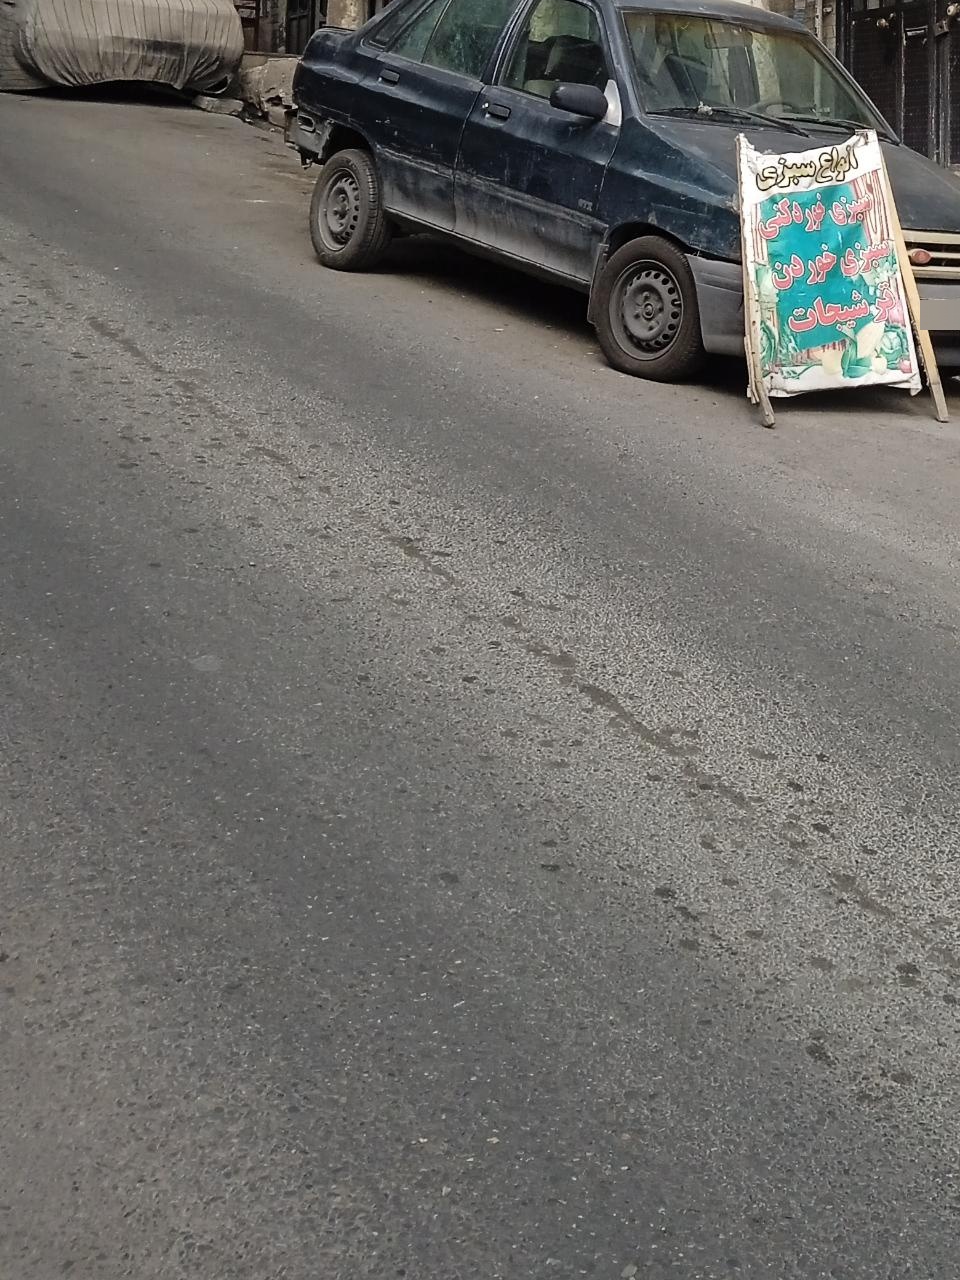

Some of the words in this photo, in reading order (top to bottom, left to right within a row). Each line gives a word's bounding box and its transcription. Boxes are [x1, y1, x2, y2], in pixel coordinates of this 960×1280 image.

[756, 156, 816, 192] سبزی
[815, 146, 858, 184] انواع
[829, 192, 873, 227] سبزی
[840, 238, 891, 278] سبزی
